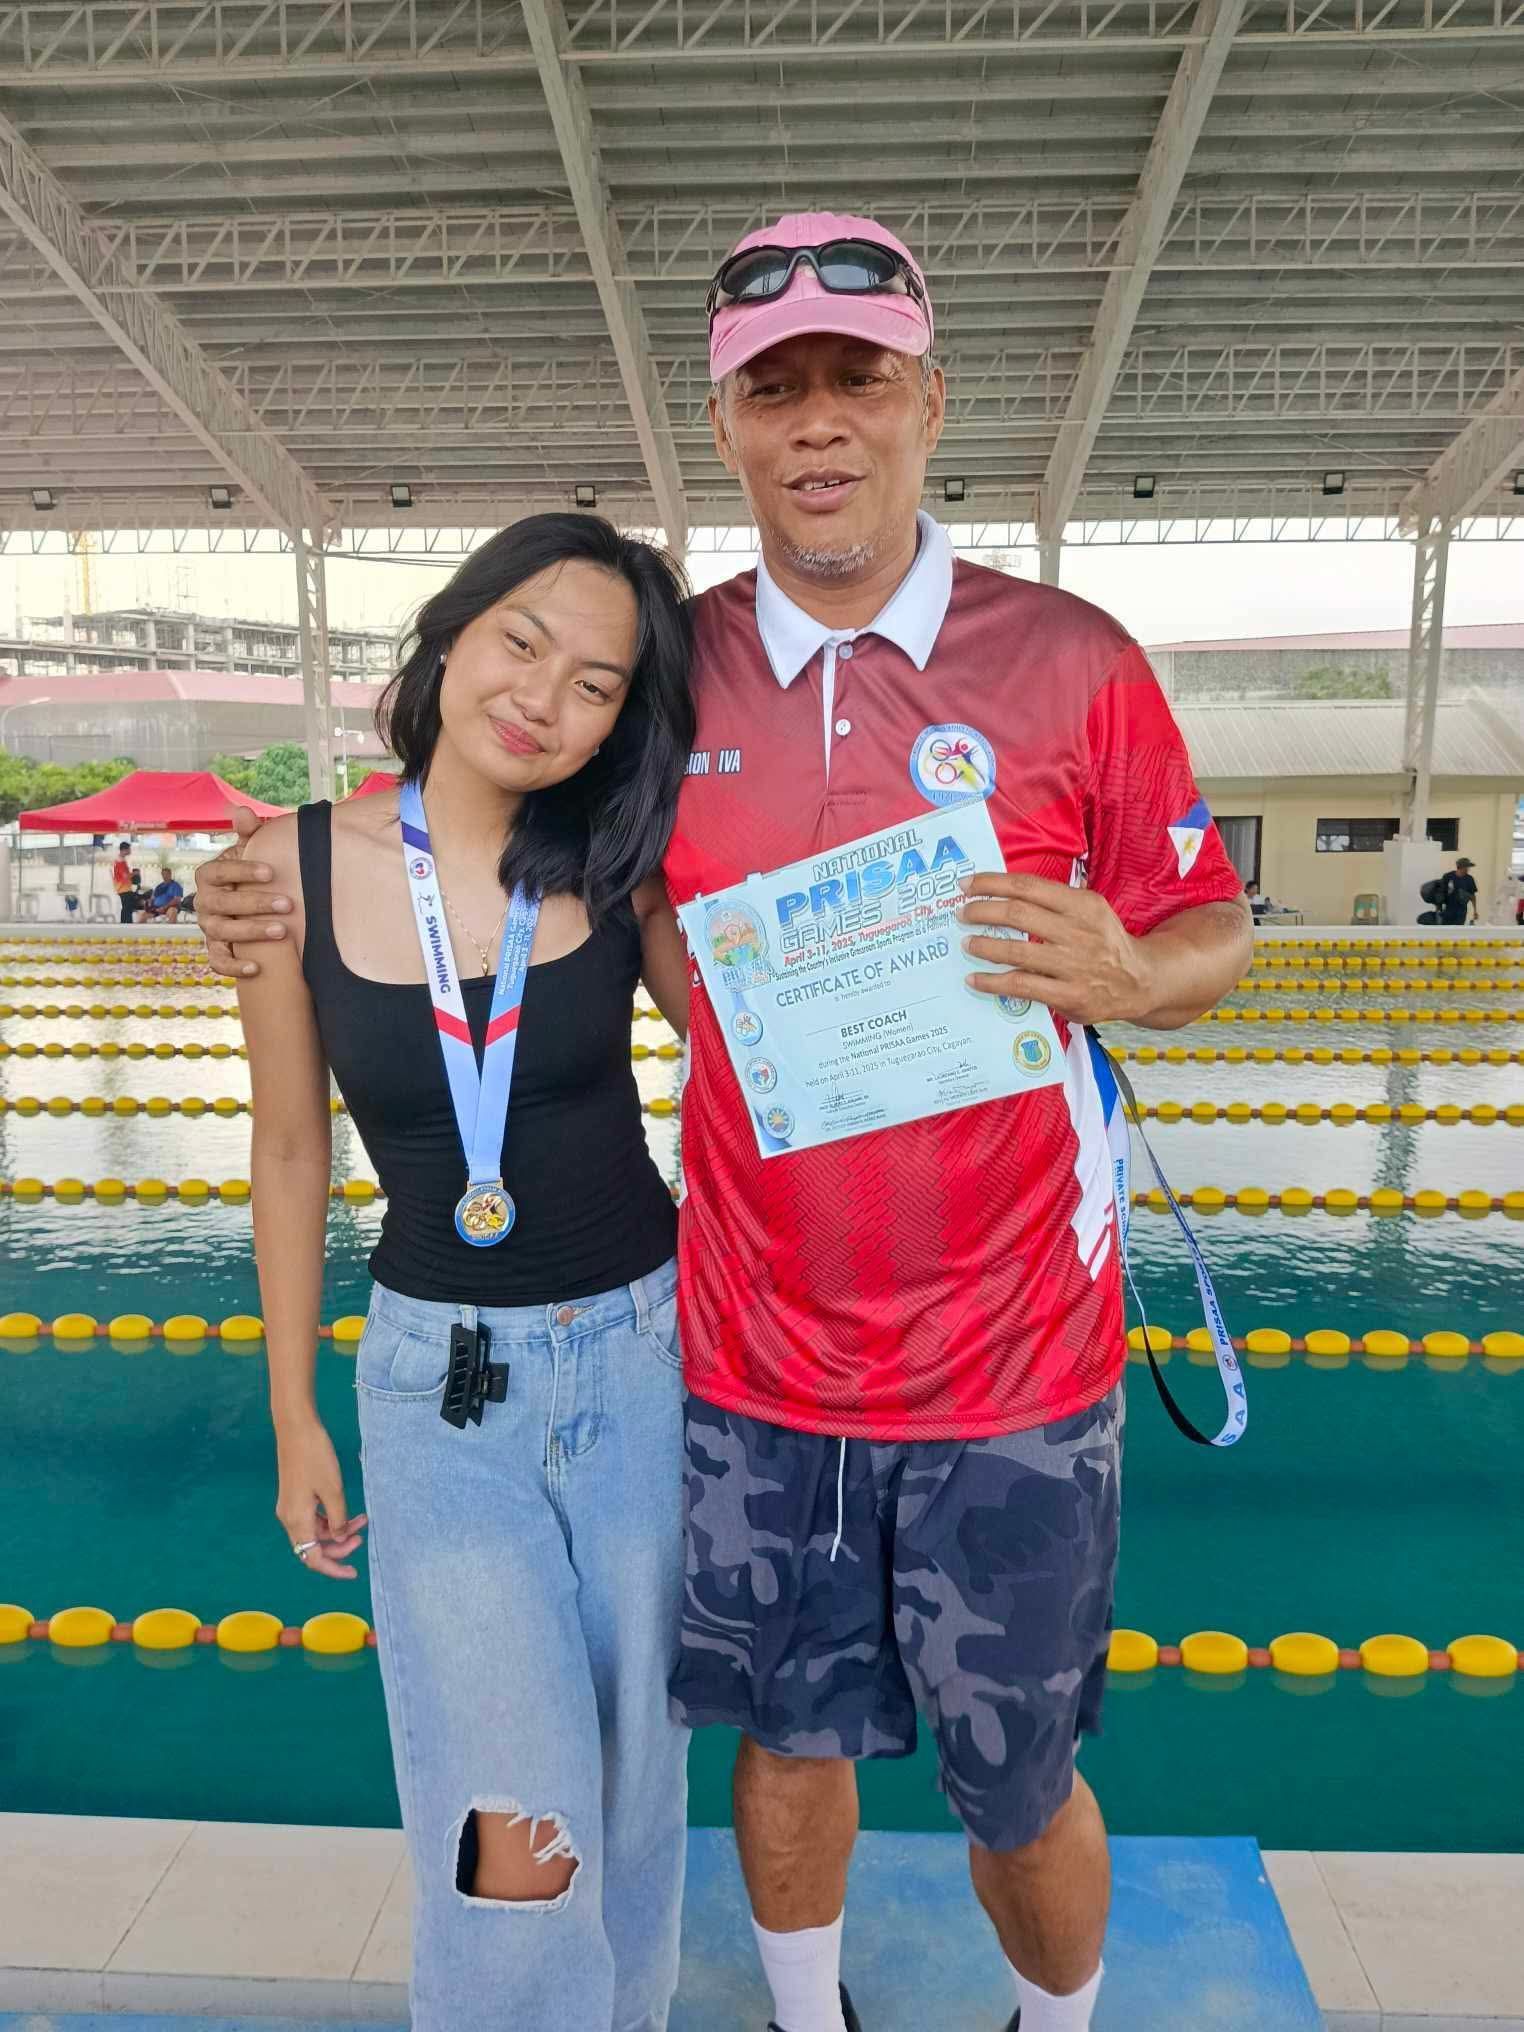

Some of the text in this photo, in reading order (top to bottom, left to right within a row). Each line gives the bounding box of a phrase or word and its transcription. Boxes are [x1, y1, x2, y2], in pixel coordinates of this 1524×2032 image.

[684, 748, 742, 775] ION IVA
[812, 828, 923, 881] NATIONAL
[775, 835, 970, 930] PRISAA
[780, 900, 883, 954] GAMES
[784, 948, 805, 967] April
[806, 941, 829, 959] 3-11,
[831, 935, 857, 951] 2025,
[858, 914, 912, 942] Tuguegarao
[914, 904, 934, 920] City,
[425, 915, 452, 995] SWIMMING
[776, 941, 949, 1007] CERTIFICATE OF AWARD
[839, 1055, 850, 1064] the
[850, 1045, 880, 1060] National
[879, 1038, 906, 1052] PRISAA
[905, 1032, 931, 1045] Games
[930, 1025, 949, 1037] 2025
[841, 1009, 907, 1038] BEST COACH
[842, 1023, 914, 1050] SWIMMING (Women)
[862, 1062, 879, 1073] 2025
[1115, 1158, 1125, 1203] PRIVATE
[1209, 1299, 1229, 1346] PRISAA
